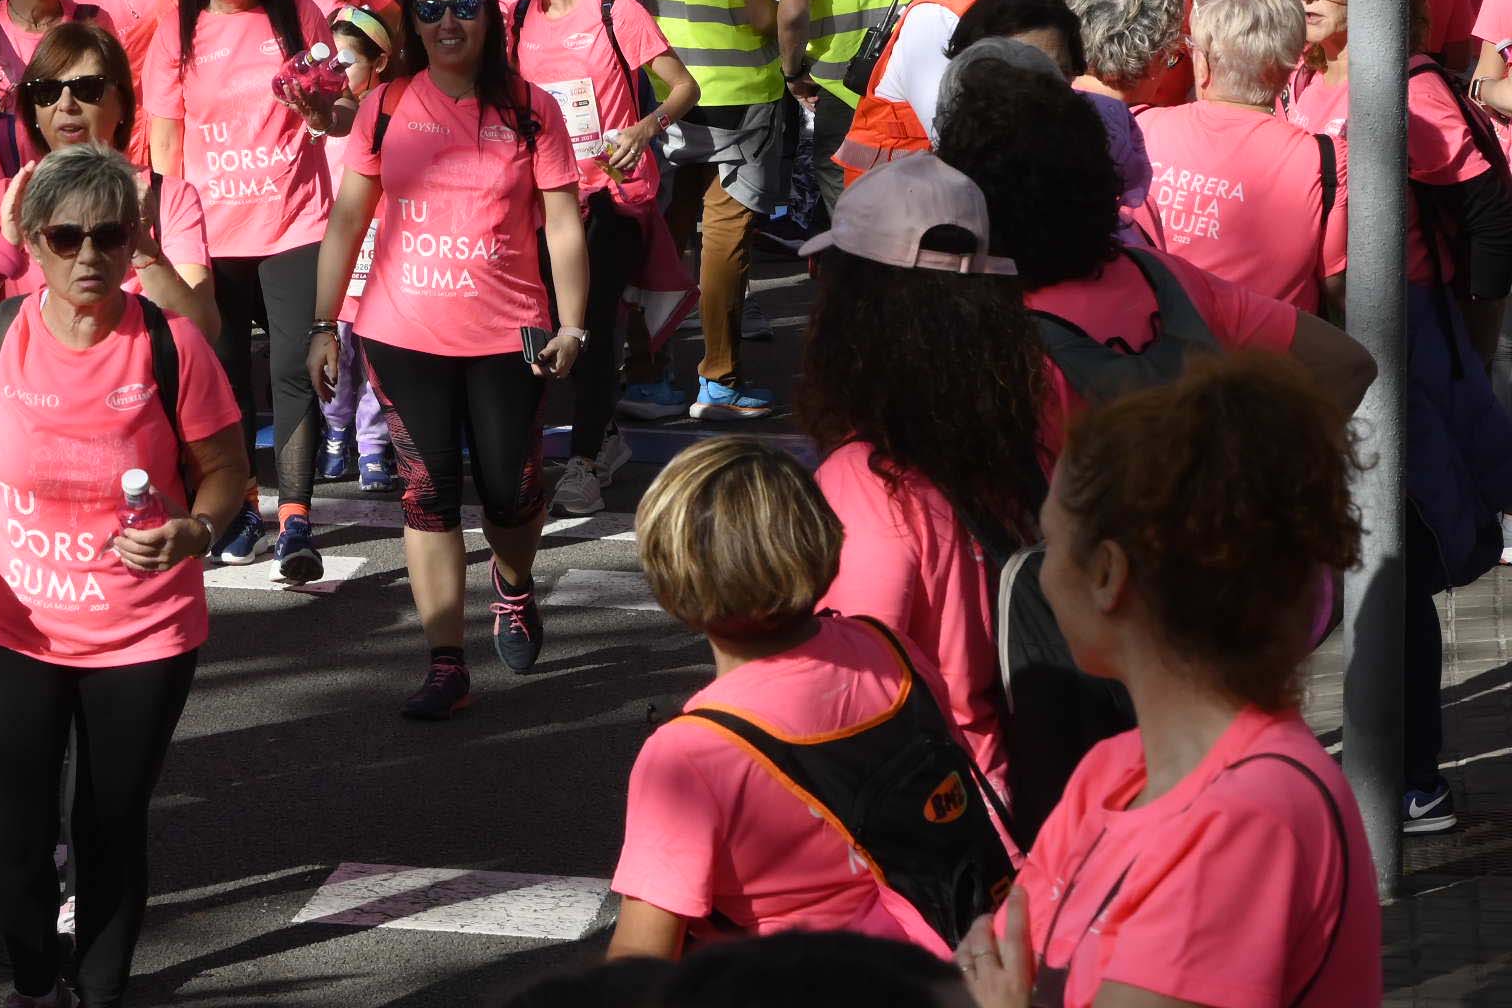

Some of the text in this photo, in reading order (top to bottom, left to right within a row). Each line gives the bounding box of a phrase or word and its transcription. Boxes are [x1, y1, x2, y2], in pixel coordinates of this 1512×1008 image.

[199, 122, 228, 143] TU
[407, 120, 451, 136] OYSHO
[206, 145, 297, 173] DORSAL
[207, 175, 278, 199] SUMA
[398, 197, 428, 223] TU
[1156, 185, 1220, 218] DE LA
[401, 230, 501, 261] DORSAL
[401, 260, 476, 290] SUMA
[4, 558, 107, 602] SUMA
[89, 602, 110, 612] 2023
